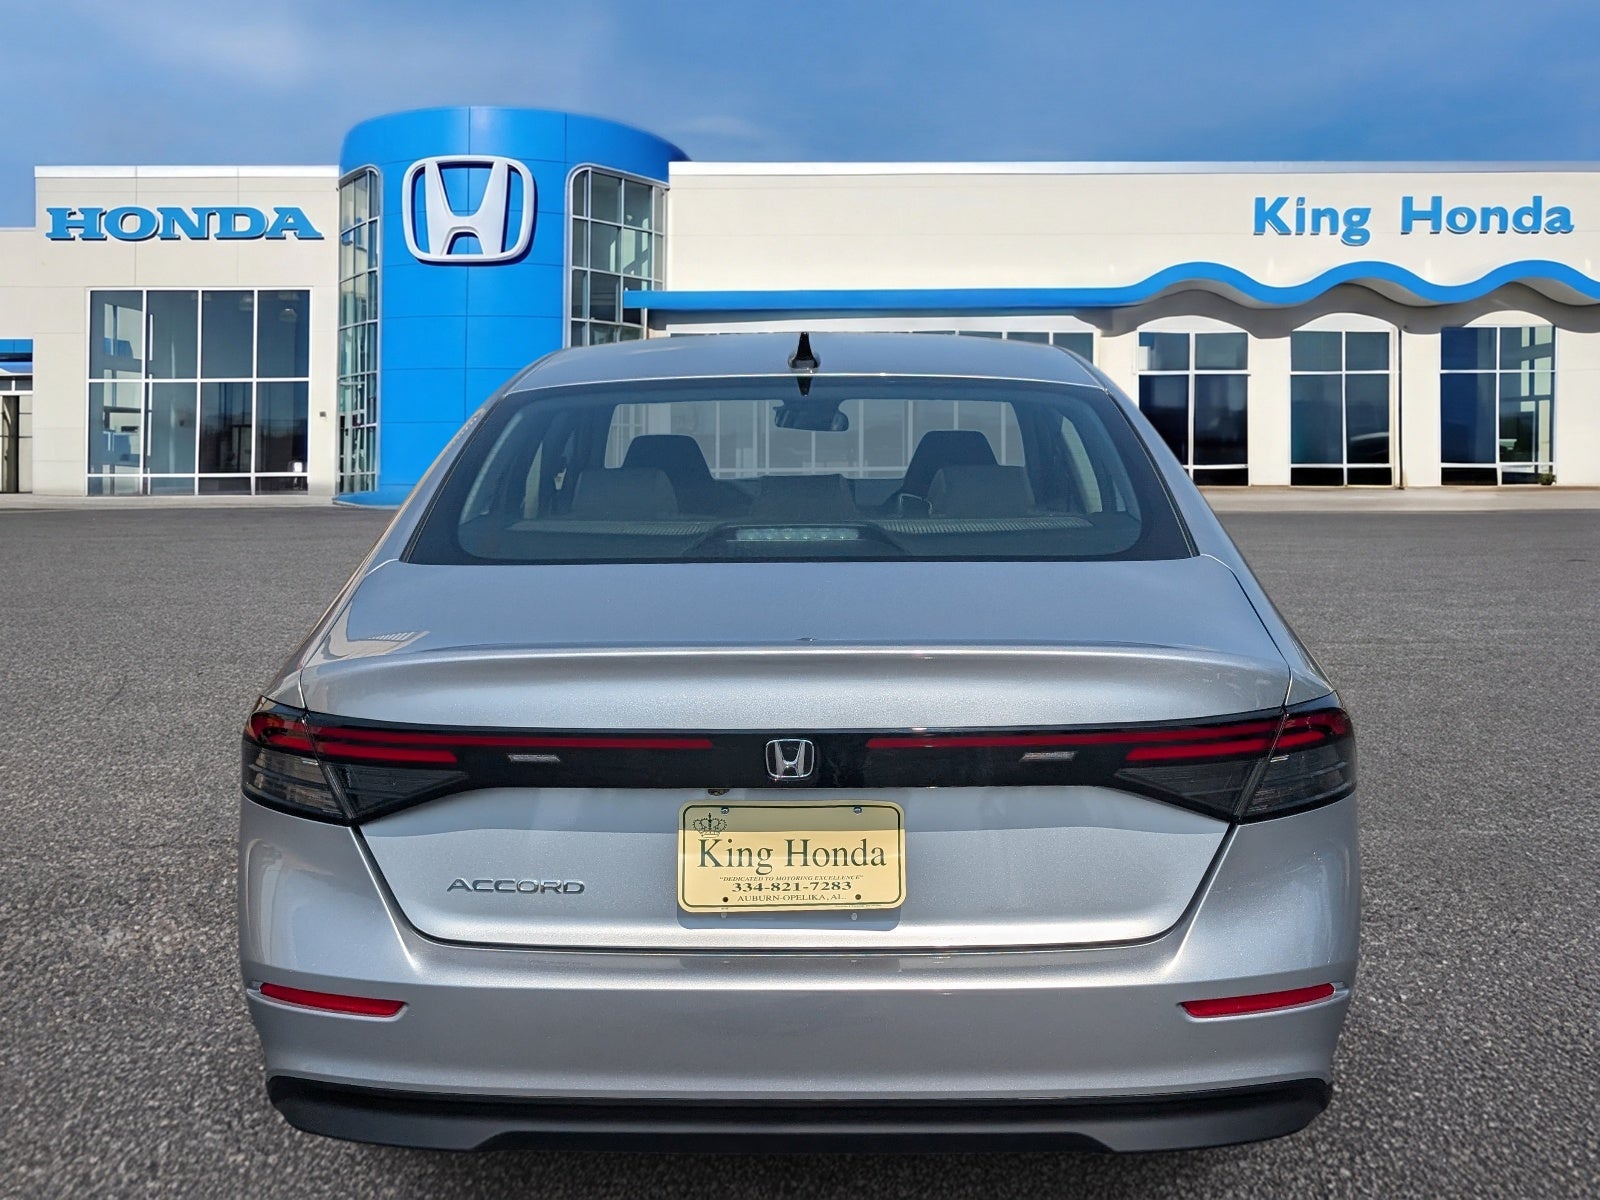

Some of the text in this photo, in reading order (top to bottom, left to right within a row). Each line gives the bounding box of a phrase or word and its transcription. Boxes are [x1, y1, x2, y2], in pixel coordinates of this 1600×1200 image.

[45, 205, 325, 242] HONDA
[1253, 195, 1575, 246] King Honda
[697, 838, 887, 875] King Honda
[447, 878, 585, 894] ACCORD
[732, 881, 852, 892] 334-821-7283
